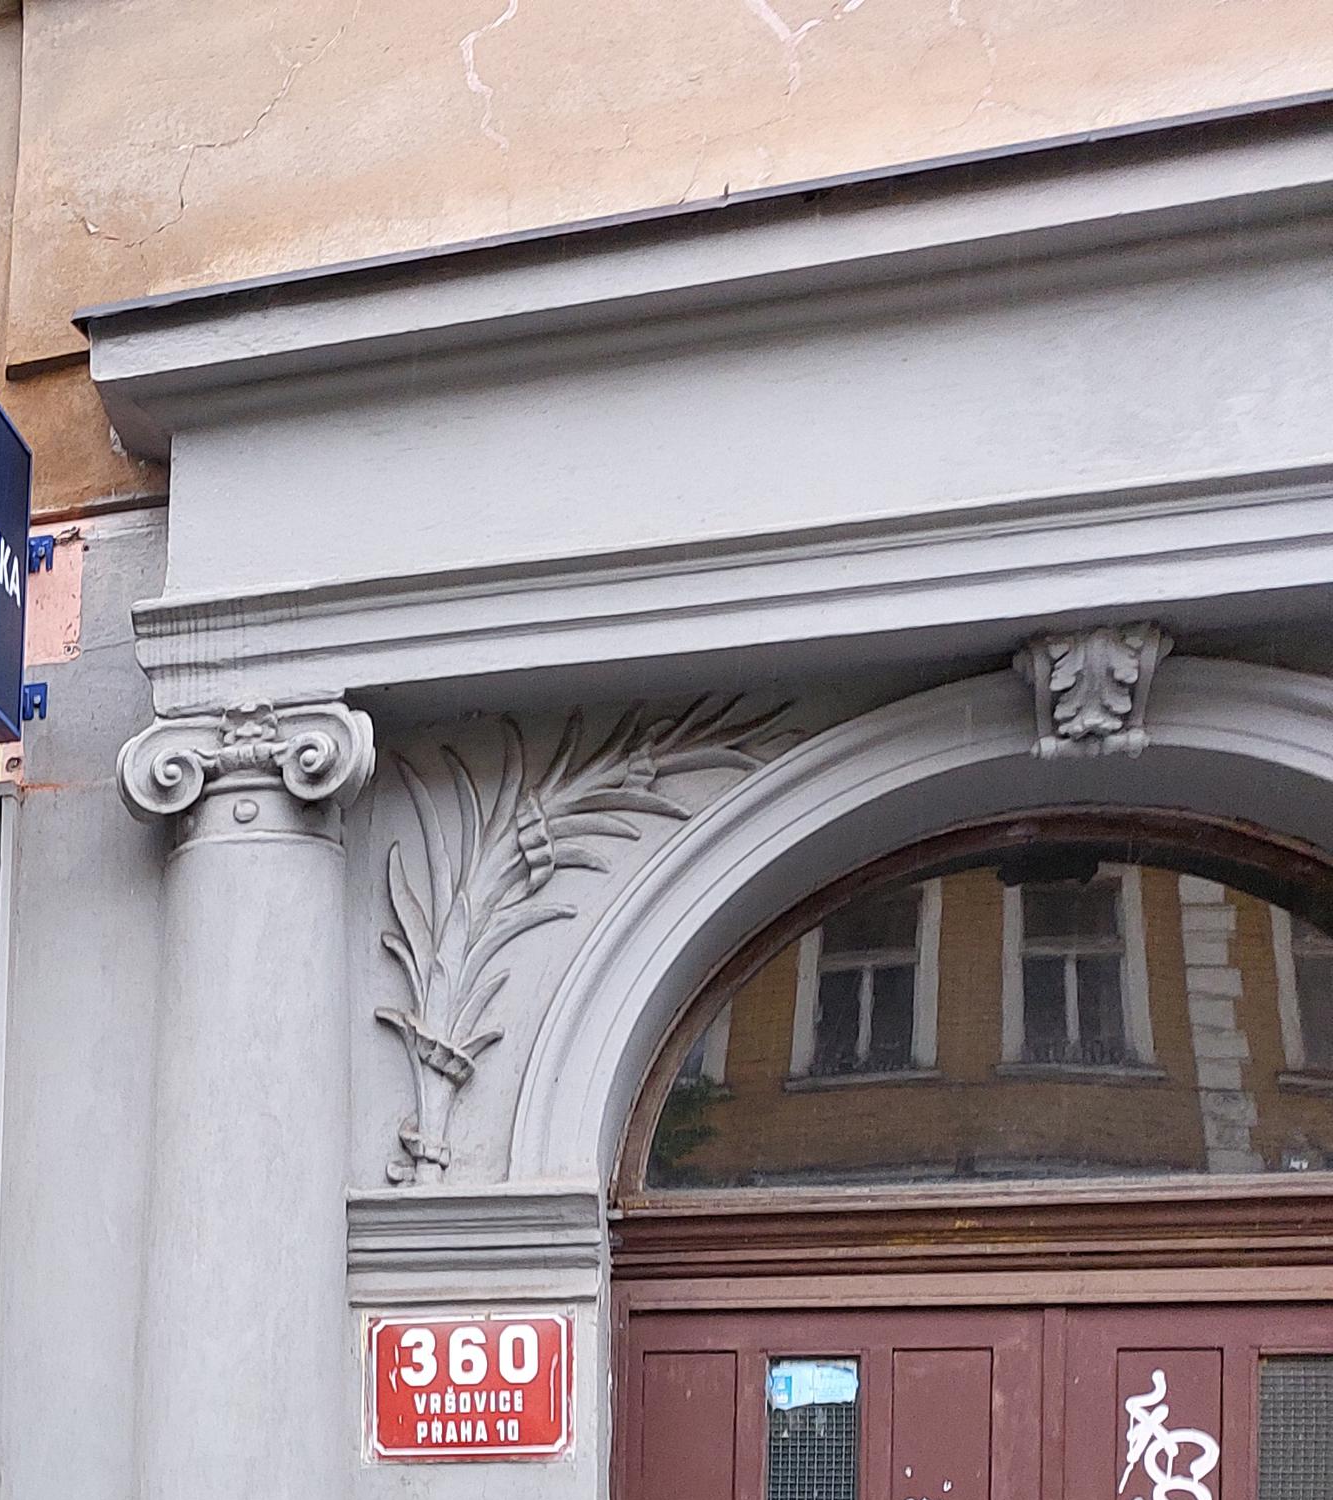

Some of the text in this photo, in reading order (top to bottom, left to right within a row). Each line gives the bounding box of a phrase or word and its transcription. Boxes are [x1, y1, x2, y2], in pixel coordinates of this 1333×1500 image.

[399, 1323, 540, 1388] 360
[413, 1385, 524, 1415] VRŠOVICE
[416, 1418, 520, 1444] PRAHA 10
